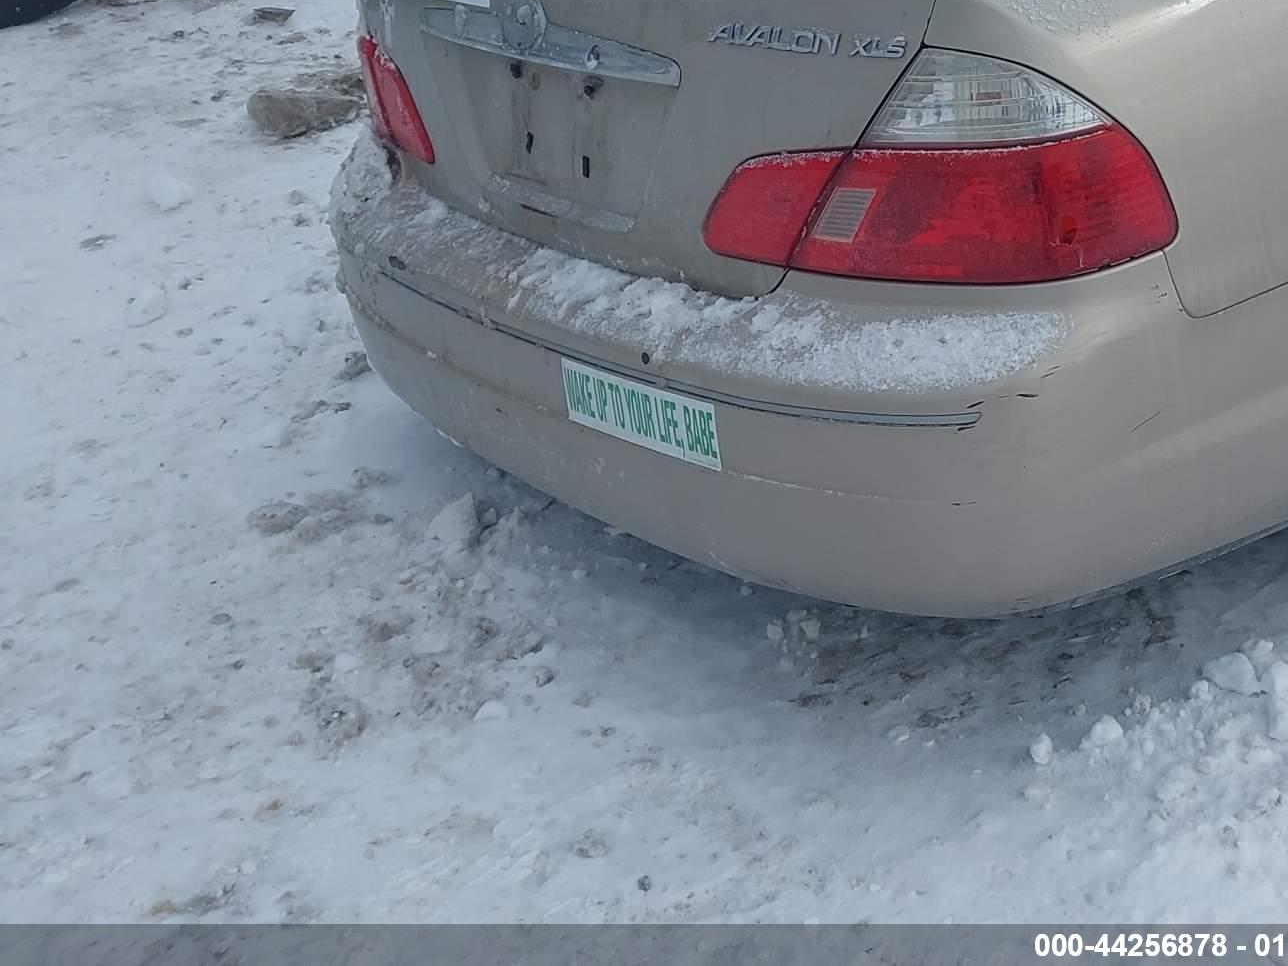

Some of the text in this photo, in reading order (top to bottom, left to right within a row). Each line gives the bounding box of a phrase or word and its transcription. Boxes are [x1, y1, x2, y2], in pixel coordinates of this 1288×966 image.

[707, 19, 907, 59] AVALON XLS
[564, 367, 719, 459] WAKE UP TO YOUR LIFE, BABE
